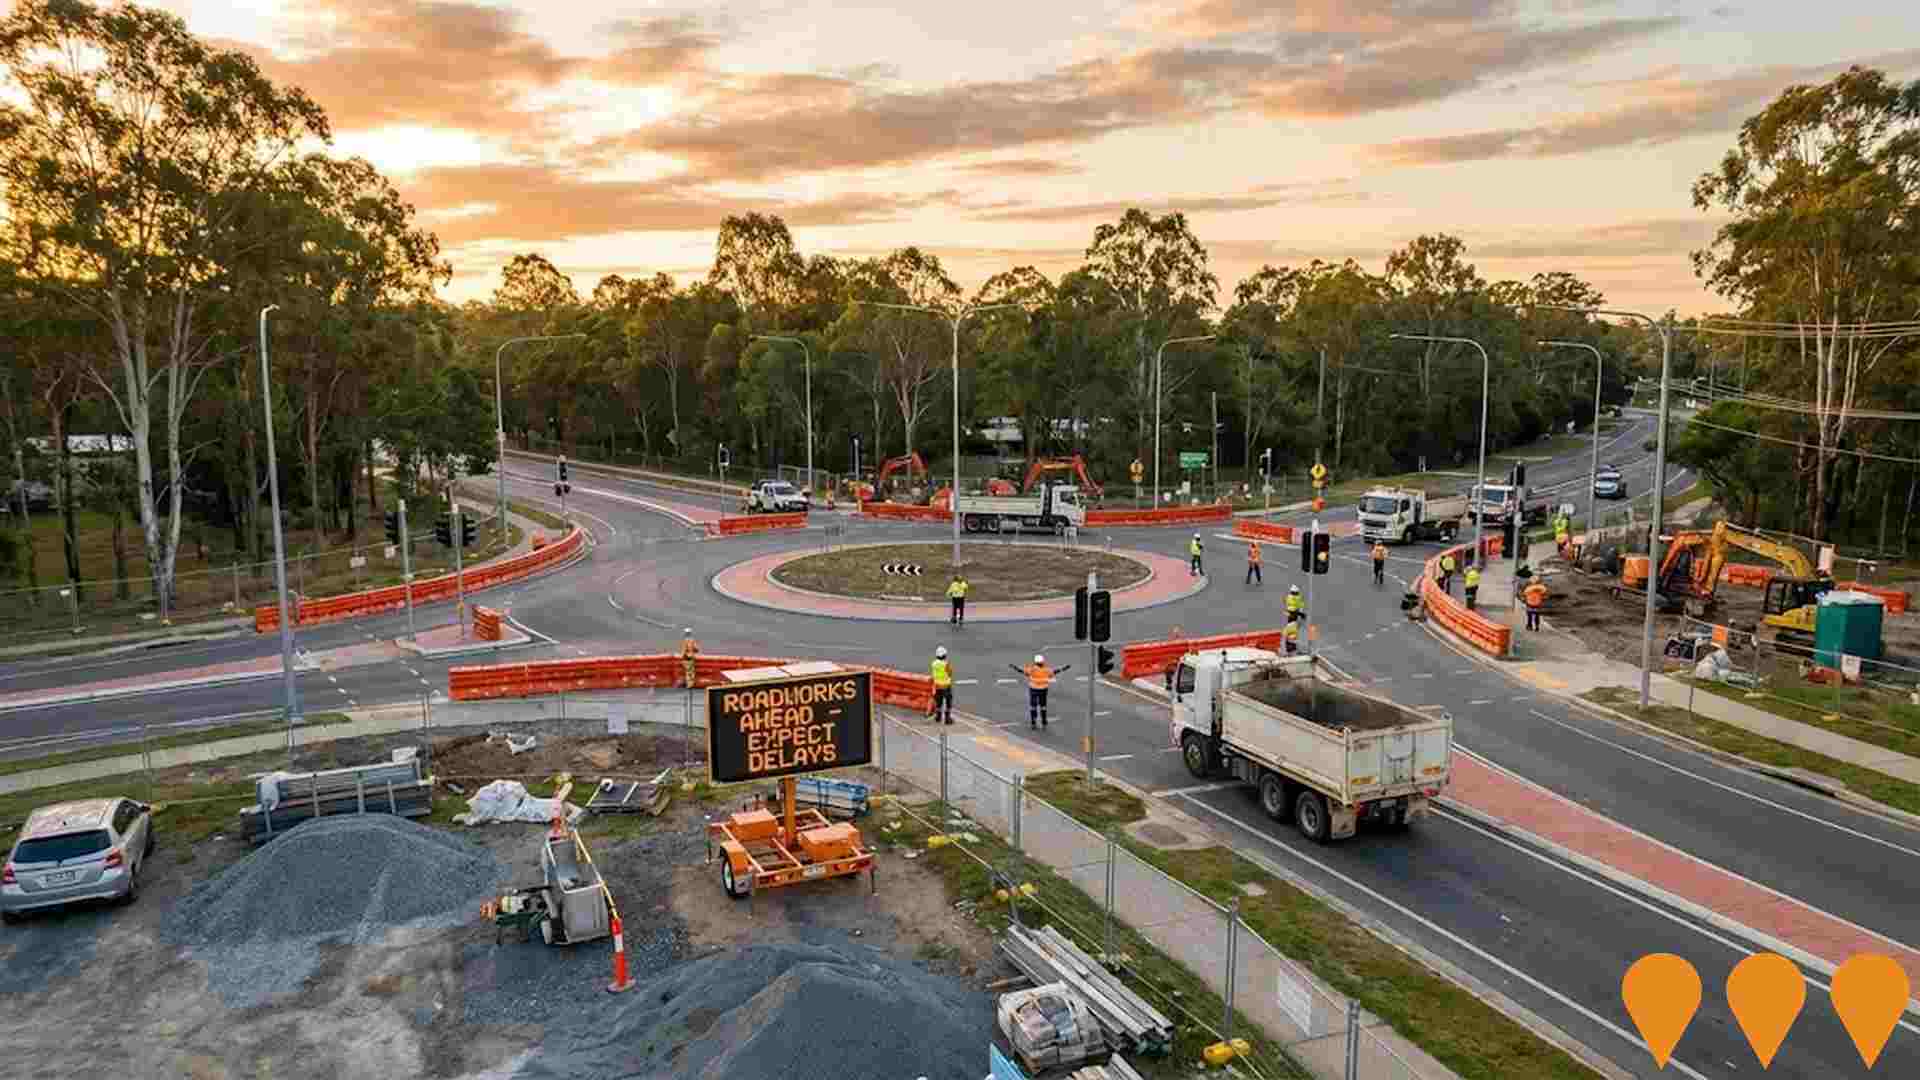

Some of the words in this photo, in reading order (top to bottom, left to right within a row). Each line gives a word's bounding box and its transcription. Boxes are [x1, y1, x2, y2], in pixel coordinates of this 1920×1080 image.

[723, 680, 857, 713] ROADWORKS
[739, 706, 814, 733] AHEAD
[748, 722, 836, 751] EXPECT
[749, 744, 837, 773] DELAYS
